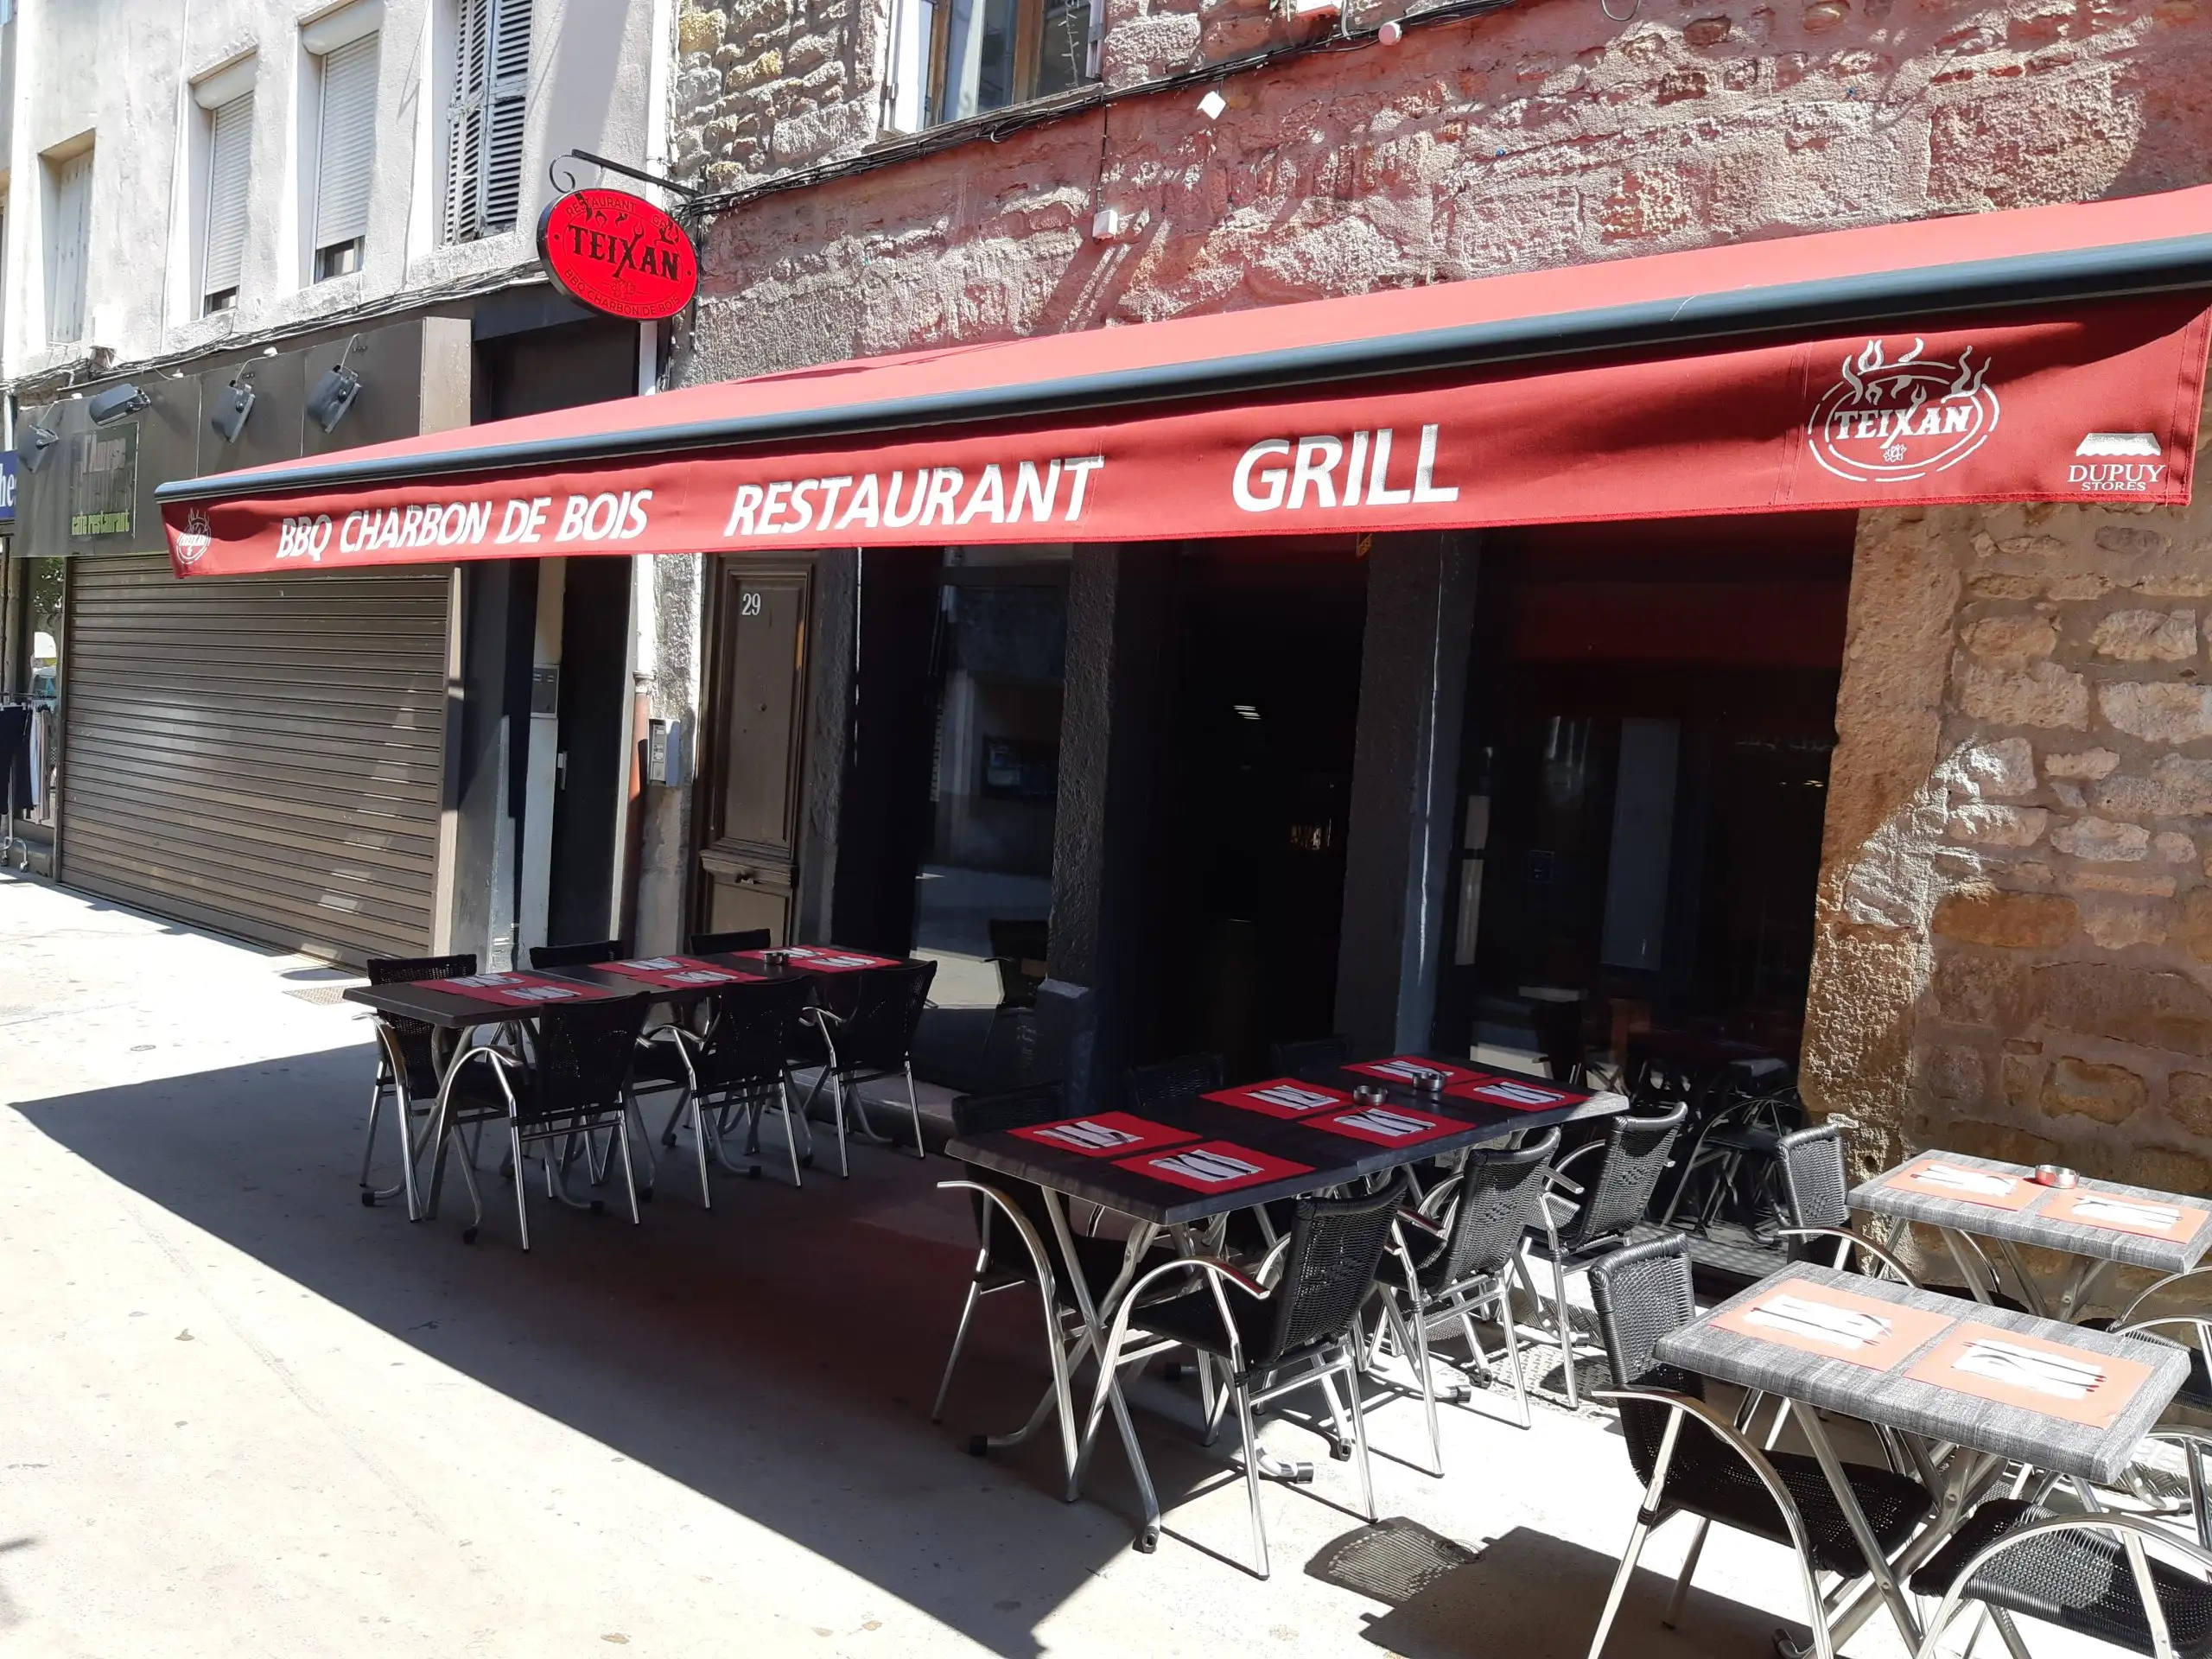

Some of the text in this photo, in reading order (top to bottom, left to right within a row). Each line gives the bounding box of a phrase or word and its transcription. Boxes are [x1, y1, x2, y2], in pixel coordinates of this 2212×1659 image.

[568, 220, 680, 282] TEIXAN
[564, 268, 681, 316] BBQ CHARBON DE BOIS
[1833, 394, 1974, 447] TEIXAN
[1231, 423, 1460, 512] GRILL
[2068, 464, 2166, 484] DUPUY
[2082, 481, 2147, 492] STORES
[722, 454, 1106, 537] RESTAURANT
[276, 488, 654, 562] BBQ CHARBON DE BOIS
[742, 593, 761, 616] 29
